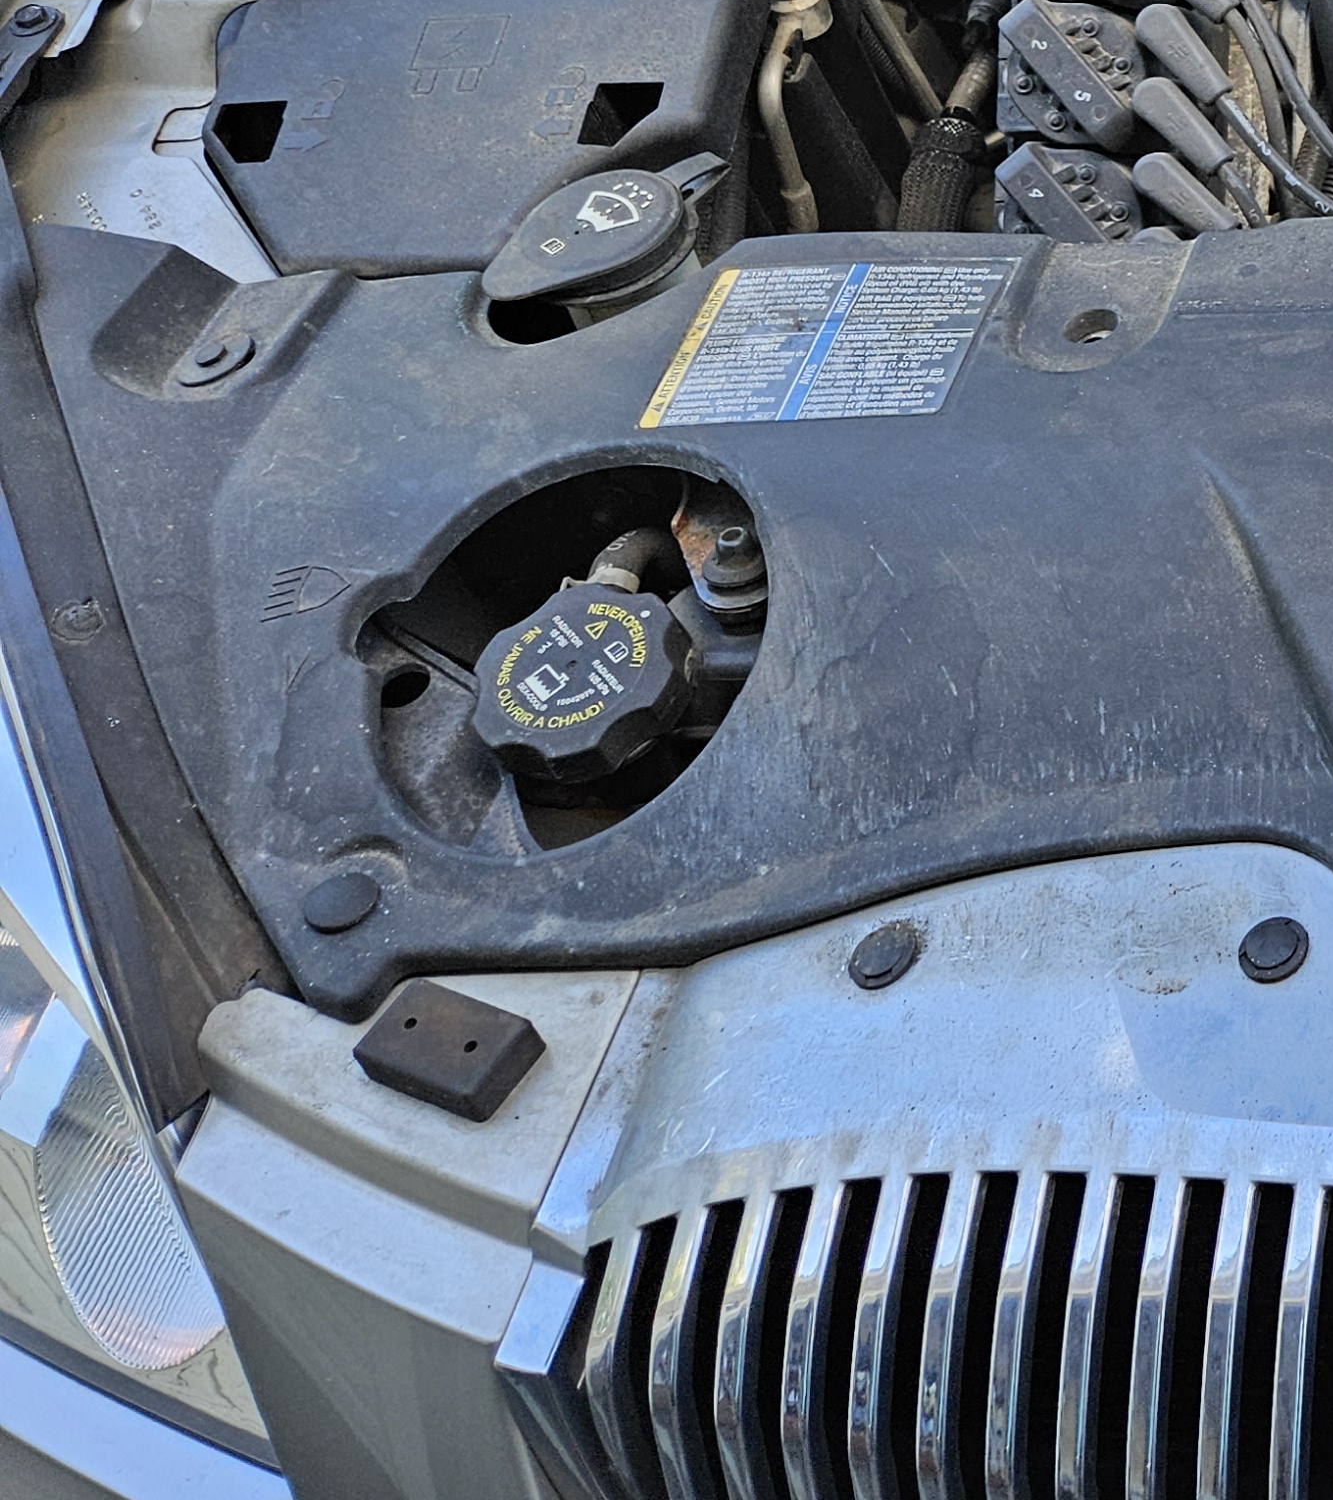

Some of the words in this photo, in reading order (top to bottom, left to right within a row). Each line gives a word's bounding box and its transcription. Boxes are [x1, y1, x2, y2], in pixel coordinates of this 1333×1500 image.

[1031, 39, 1048, 50] 2
[1073, 90, 1092, 102] 5
[1028, 188, 1045, 199] 4
[702, 284, 728, 321] CAUTION
[833, 284, 858, 313] NOTICE
[659, 352, 690, 400] ATTENTION
[799, 364, 818, 386] AVIS
[520, 625, 543, 645] NE
[552, 615, 584, 649] RADIATOR
[587, 603, 627, 621] NEVER
[622, 615, 646, 644] OPEN
[496, 643, 523, 686] JAMAIS
[591, 659, 625, 694] RADIATEUR
[498, 688, 534, 726] OUVRIR
[548, 701, 605, 728] CHAUD!
[533, 716, 545, 728] A
